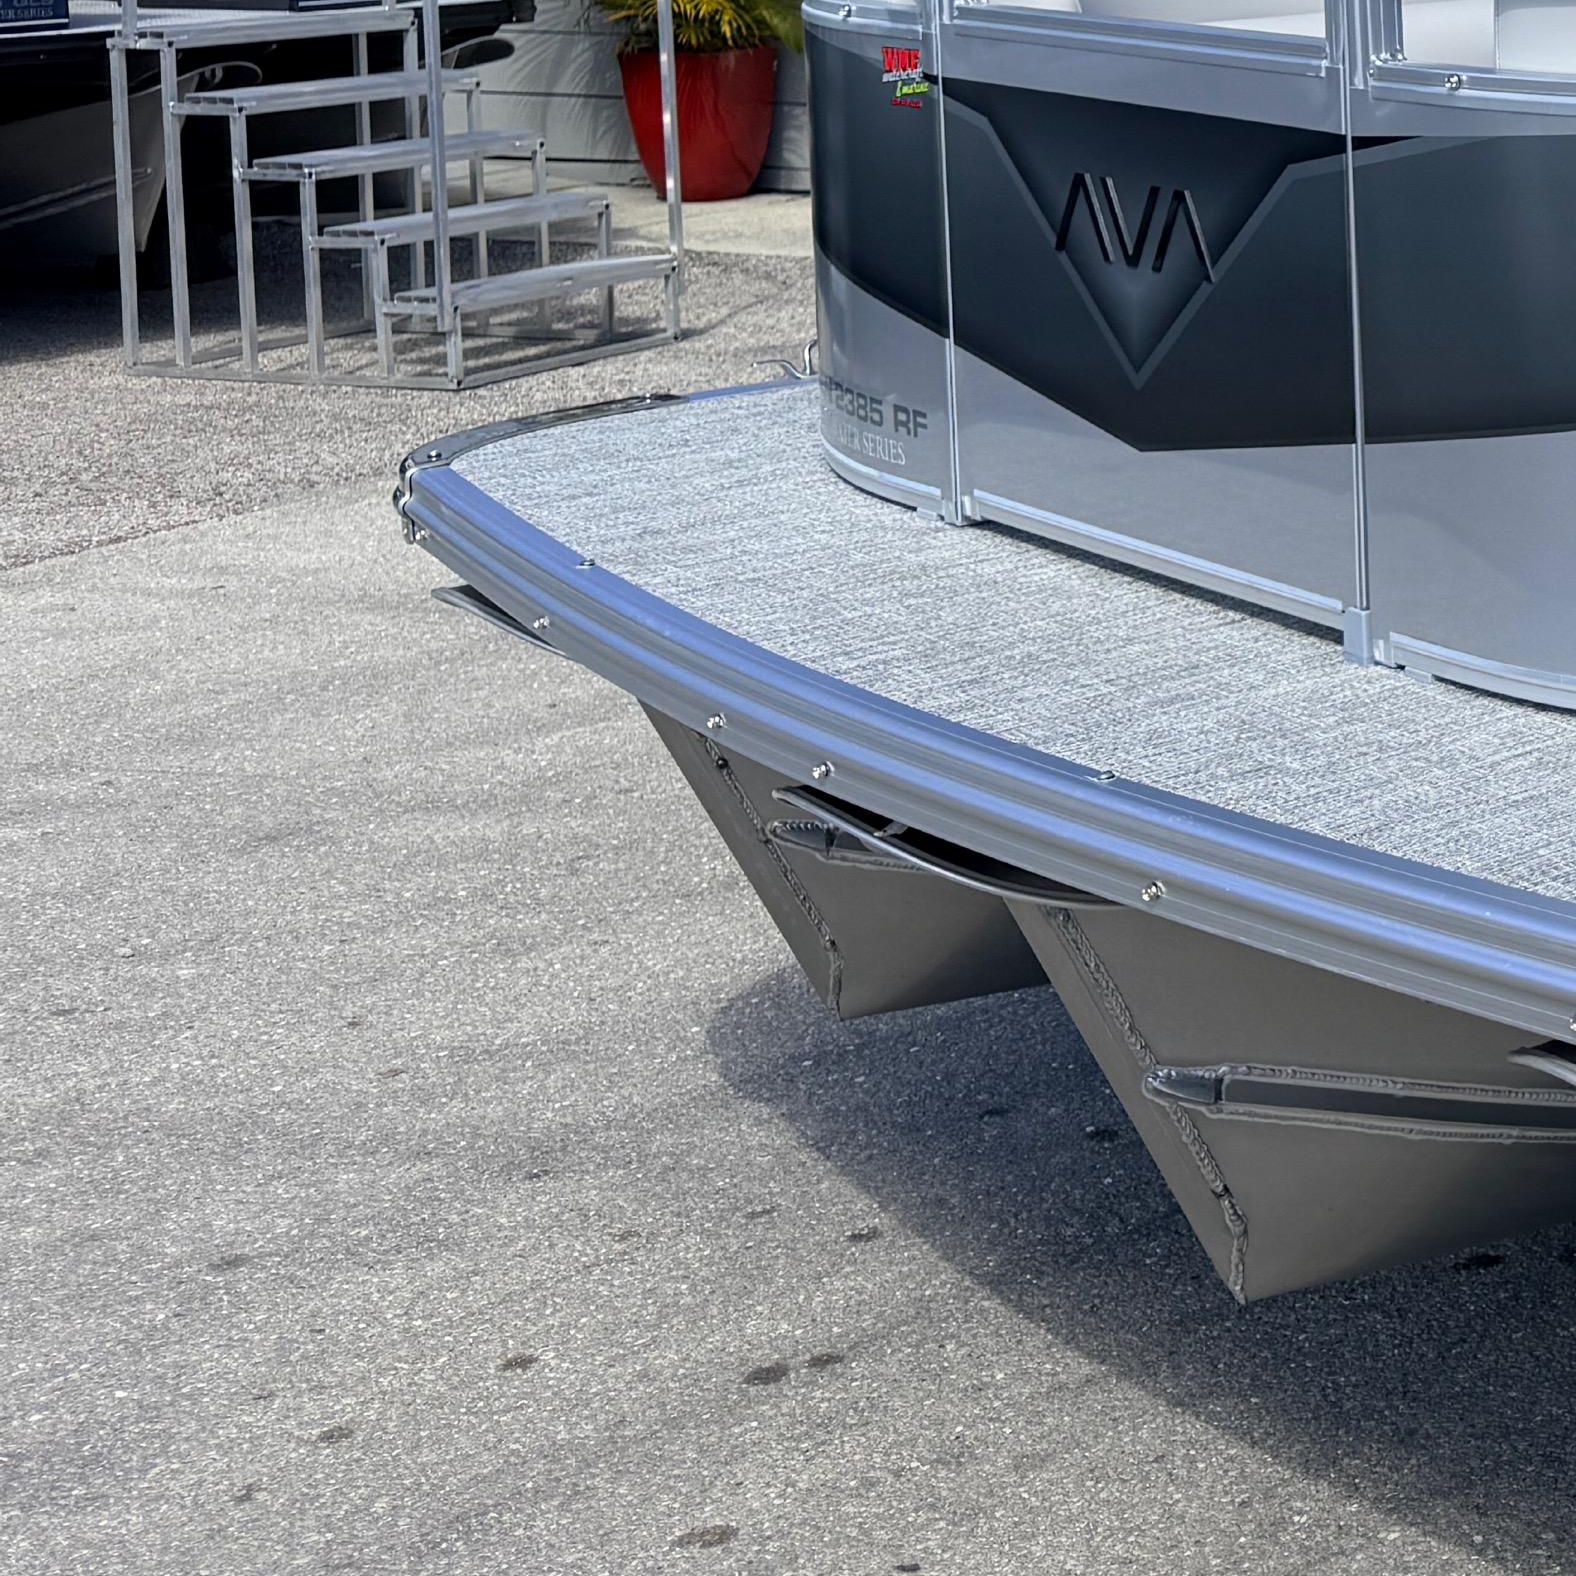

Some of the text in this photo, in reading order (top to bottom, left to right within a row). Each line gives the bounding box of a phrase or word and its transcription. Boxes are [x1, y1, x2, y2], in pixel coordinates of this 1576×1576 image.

[1055, 172, 1215, 284] AVA
[893, 403, 928, 438] RF
[862, 431, 906, 465] SERIES
